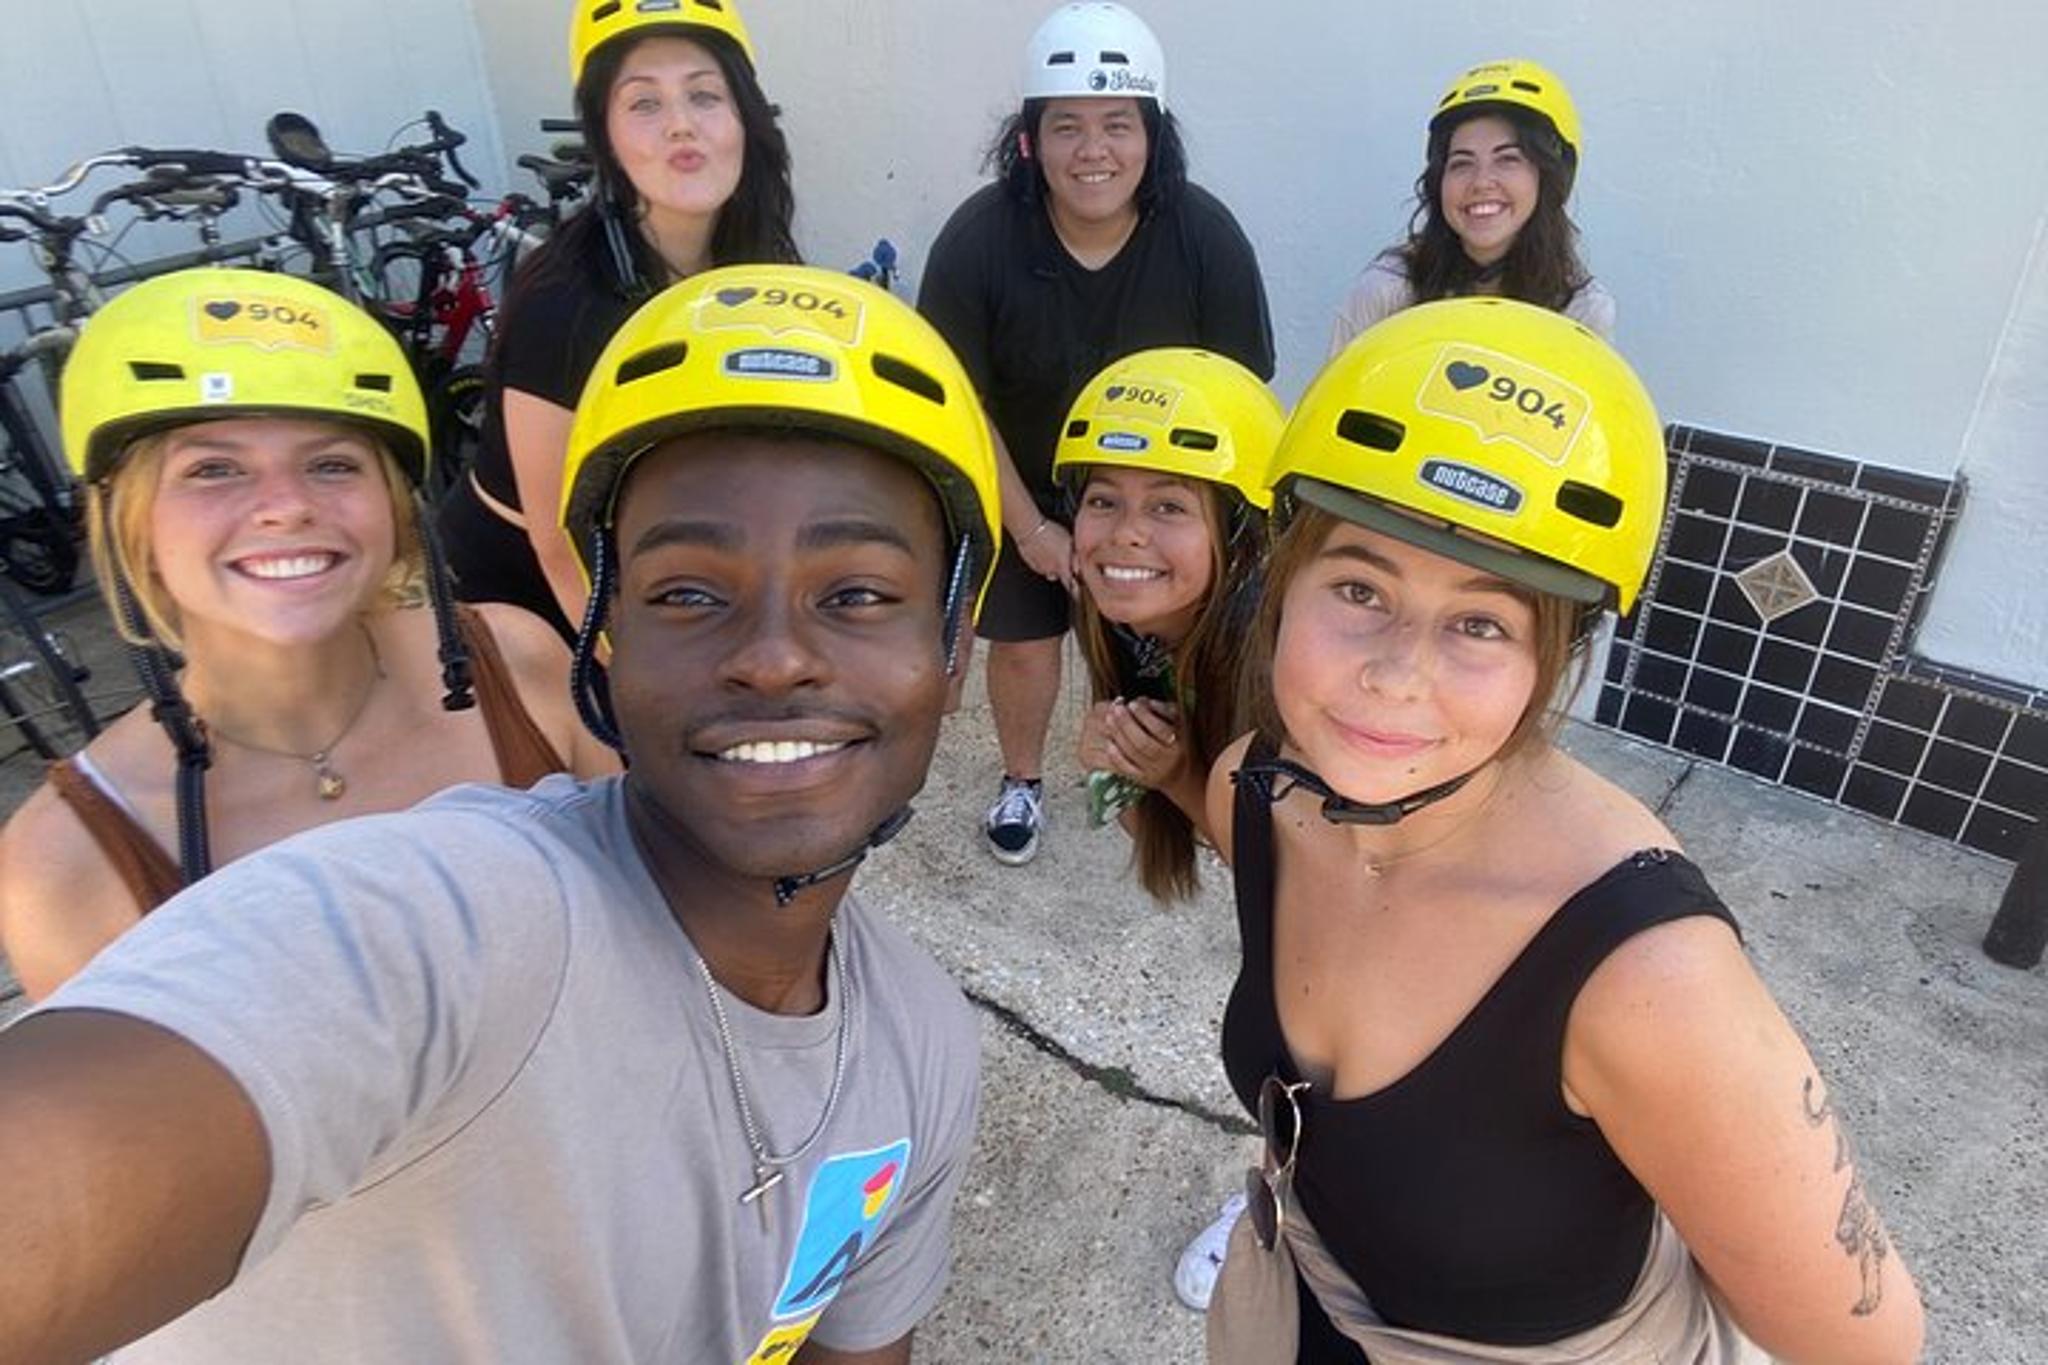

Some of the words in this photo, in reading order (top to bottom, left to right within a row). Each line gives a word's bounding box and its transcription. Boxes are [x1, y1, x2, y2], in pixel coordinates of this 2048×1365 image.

[248, 304, 319, 330] 904
[762, 289, 846, 319] 904
[1125, 386, 1167, 407] 904
[1488, 377, 1566, 430] 904
[1432, 465, 1510, 506] nutcase
